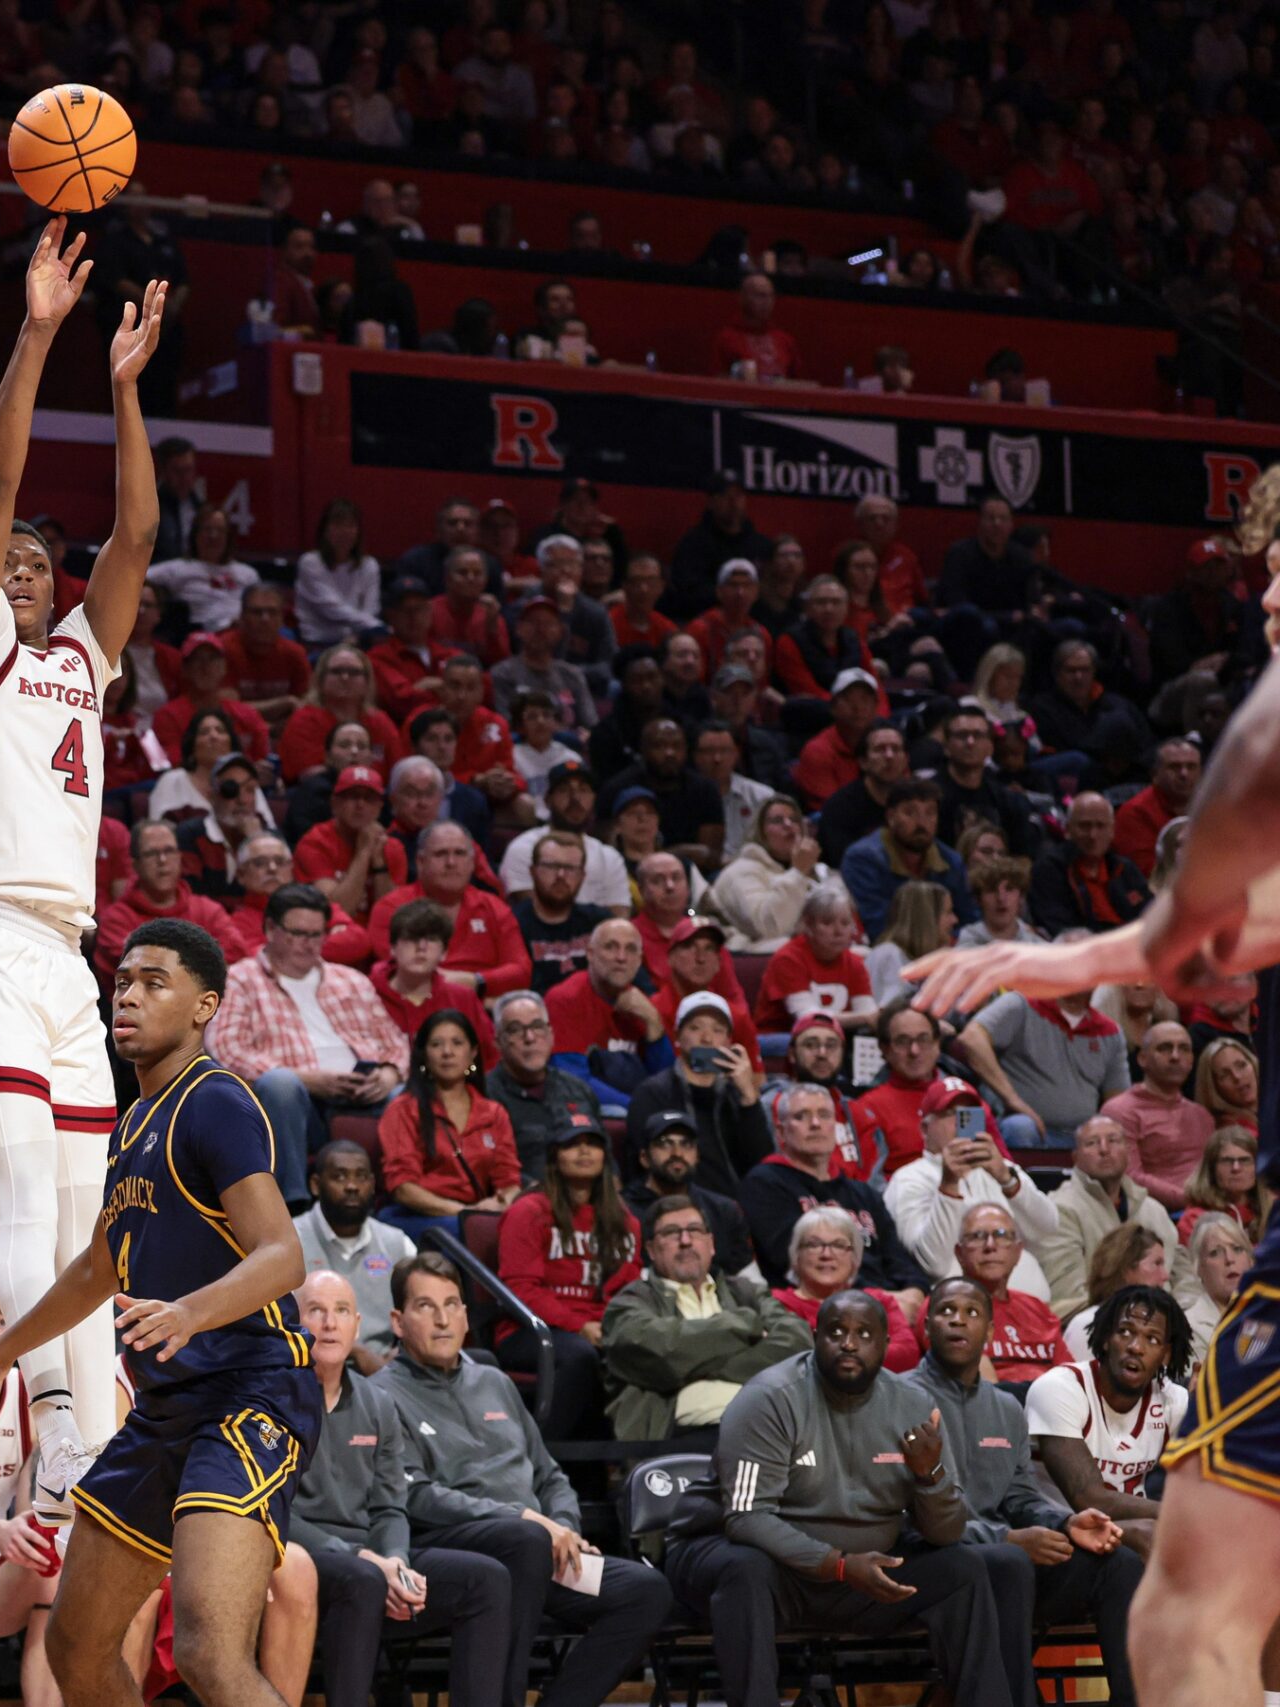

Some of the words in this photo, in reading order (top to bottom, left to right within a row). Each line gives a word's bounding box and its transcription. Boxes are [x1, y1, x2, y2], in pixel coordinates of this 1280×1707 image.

[491, 393, 565, 472] R
[742, 443, 900, 502] Horizon
[1204, 450, 1262, 521] R
[51, 718, 90, 799] 4
[117, 1231, 131, 1292] 4
[1149, 1404, 1164, 1418] C
